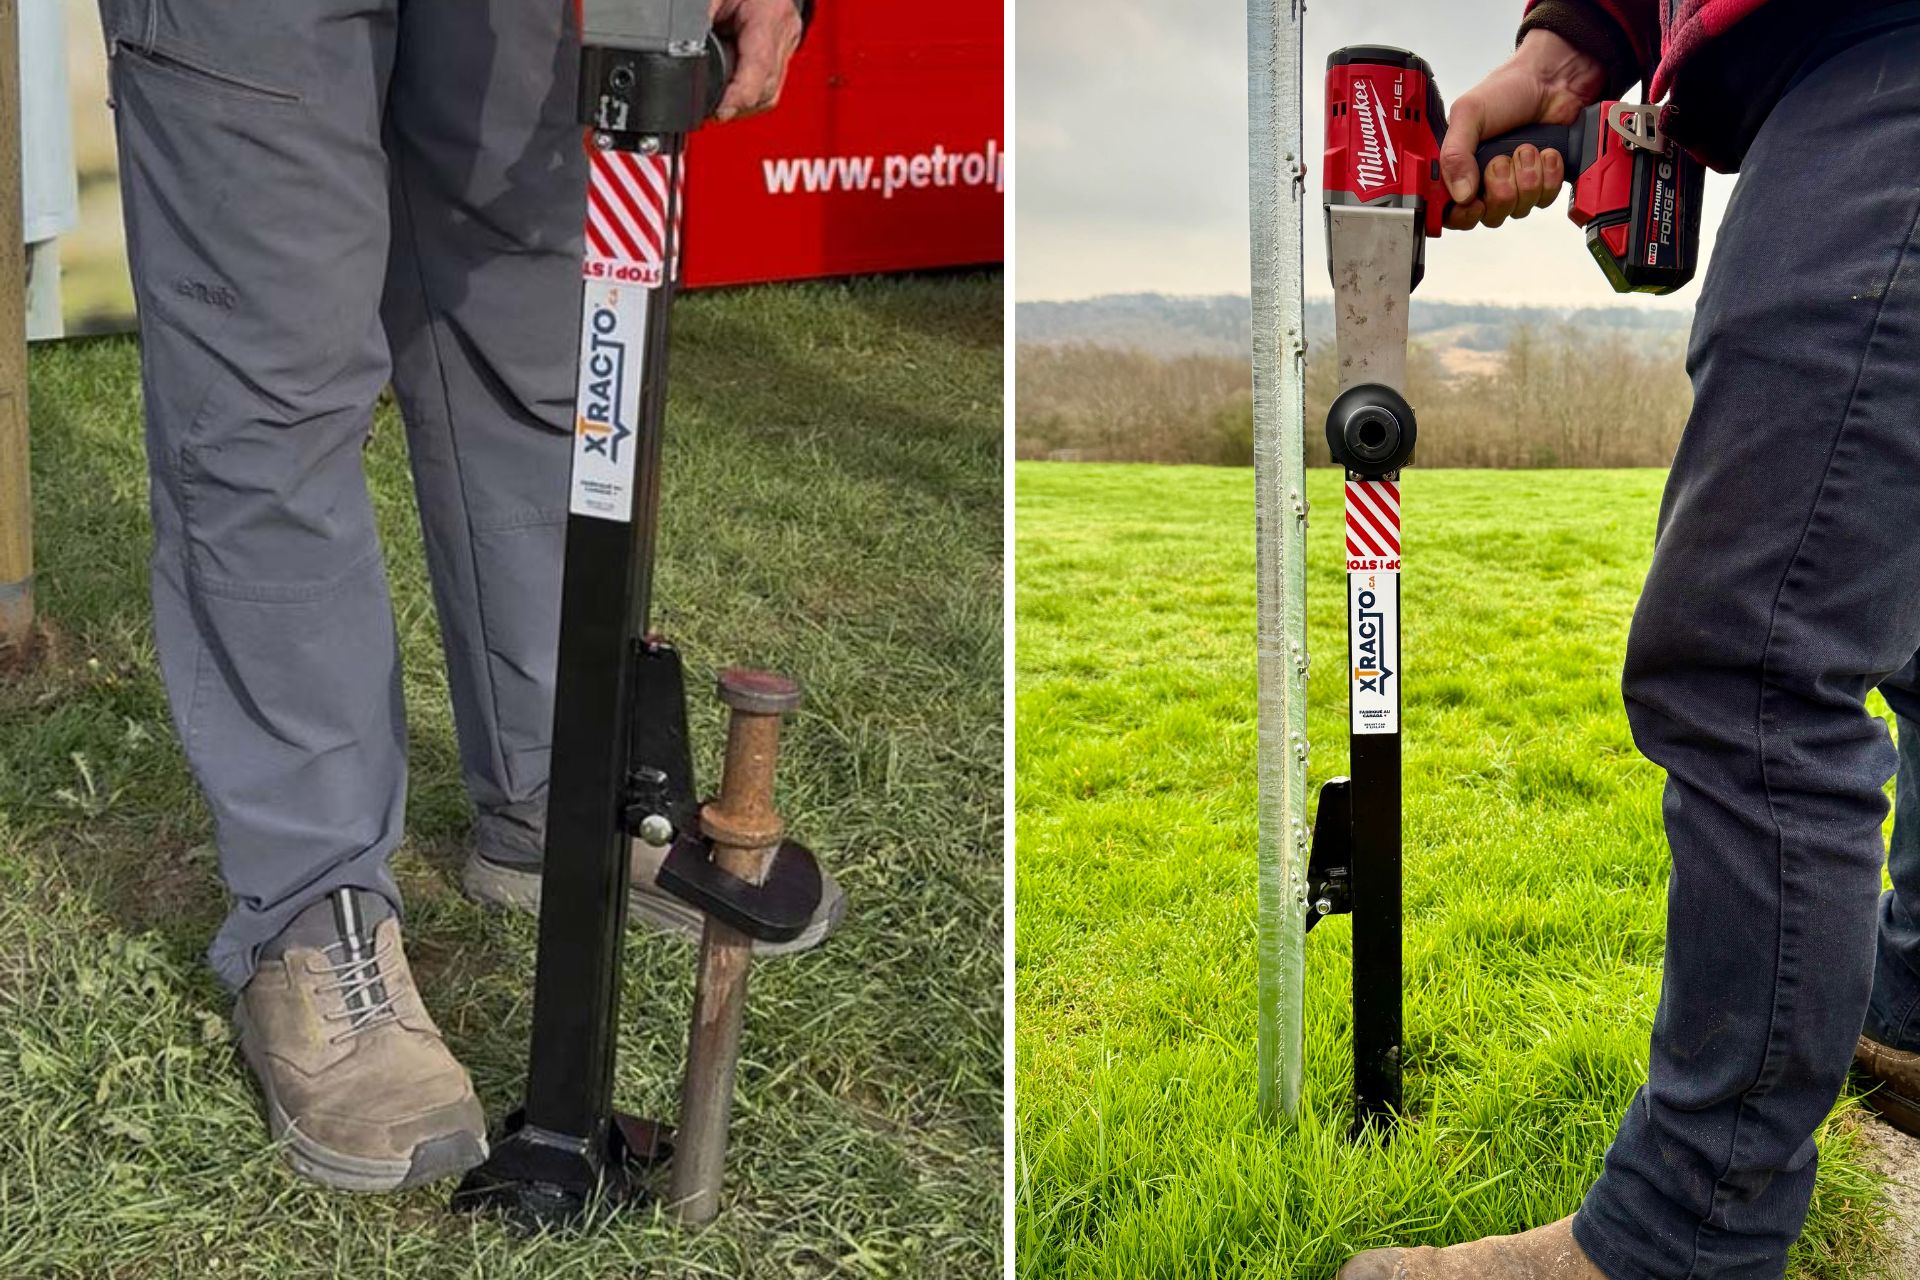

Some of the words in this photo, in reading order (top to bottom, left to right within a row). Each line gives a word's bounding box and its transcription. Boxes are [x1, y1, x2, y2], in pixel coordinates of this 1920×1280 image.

[1394, 73, 1403, 120] FUEL
[1353, 79, 1387, 191] Milwaukee
[762, 139, 1004, 199] www.petrol
[1660, 188, 1675, 245] FORGE
[1648, 243, 1657, 264] M18
[1354, 590, 1377, 693] XTRACTO
